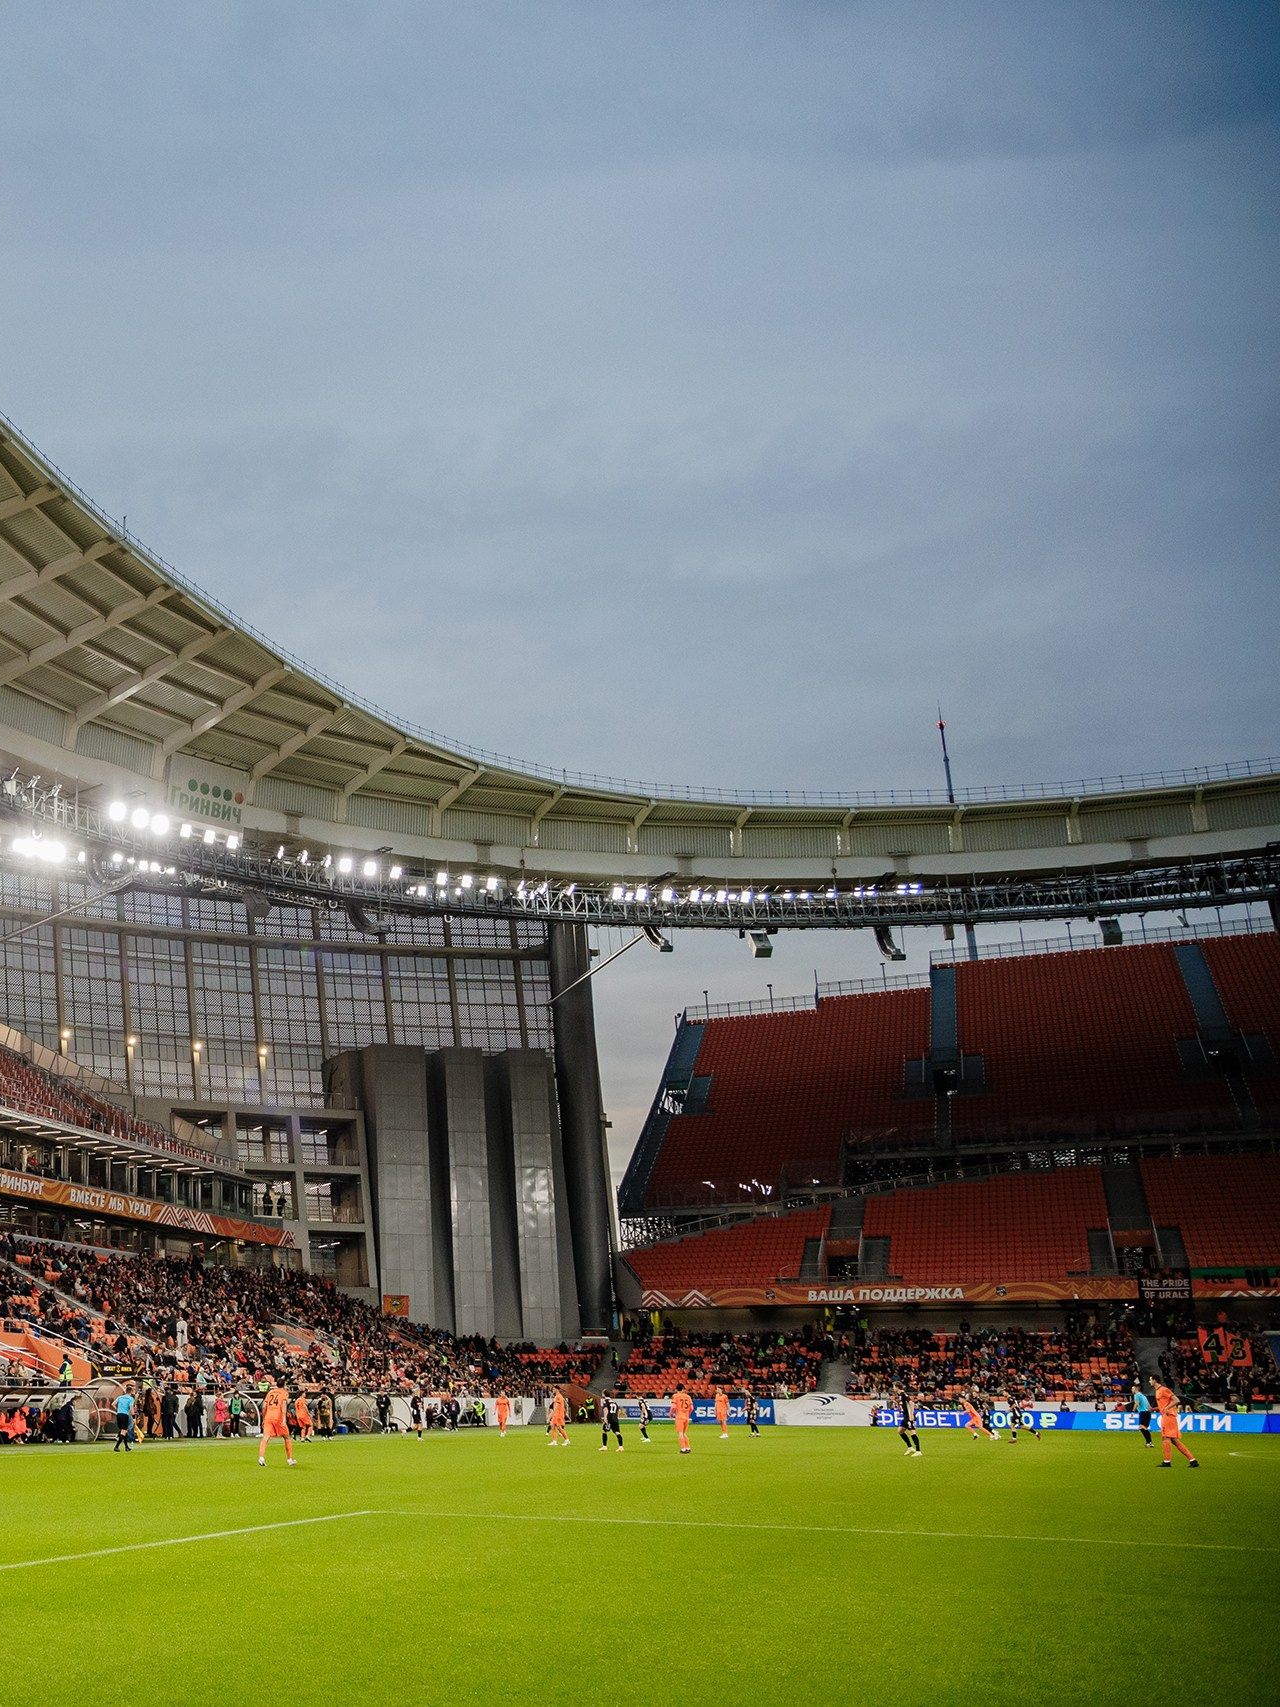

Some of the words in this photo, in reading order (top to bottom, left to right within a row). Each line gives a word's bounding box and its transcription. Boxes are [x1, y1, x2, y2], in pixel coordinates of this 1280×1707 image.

[170, 785, 242, 824] ГРИНВИЧ
[70, 1189, 105, 1208] ВМЕСТЕ
[108, 1196, 125, 1212] МЫ
[128, 1201, 152, 1217] УРАЛ
[1141, 1279, 1160, 1288] THE
[1162, 1278, 1190, 1287] PRIDE
[807, 1289, 855, 1302] ВАША
[859, 1287, 964, 1302] ПОДДЕРЖКА
[1144, 1291, 1156, 1299] OF
[1159, 1290, 1190, 1299] URALS
[1203, 1333, 1225, 1356] 4
[1229, 1337, 1247, 1361] 3
[268, 1394, 279, 1407] 24
[680, 1399, 689, 1410] 75
[694, 1406, 771, 1418] БЕСИИ
[1103, 1413, 1232, 1431] БЕИТИ
